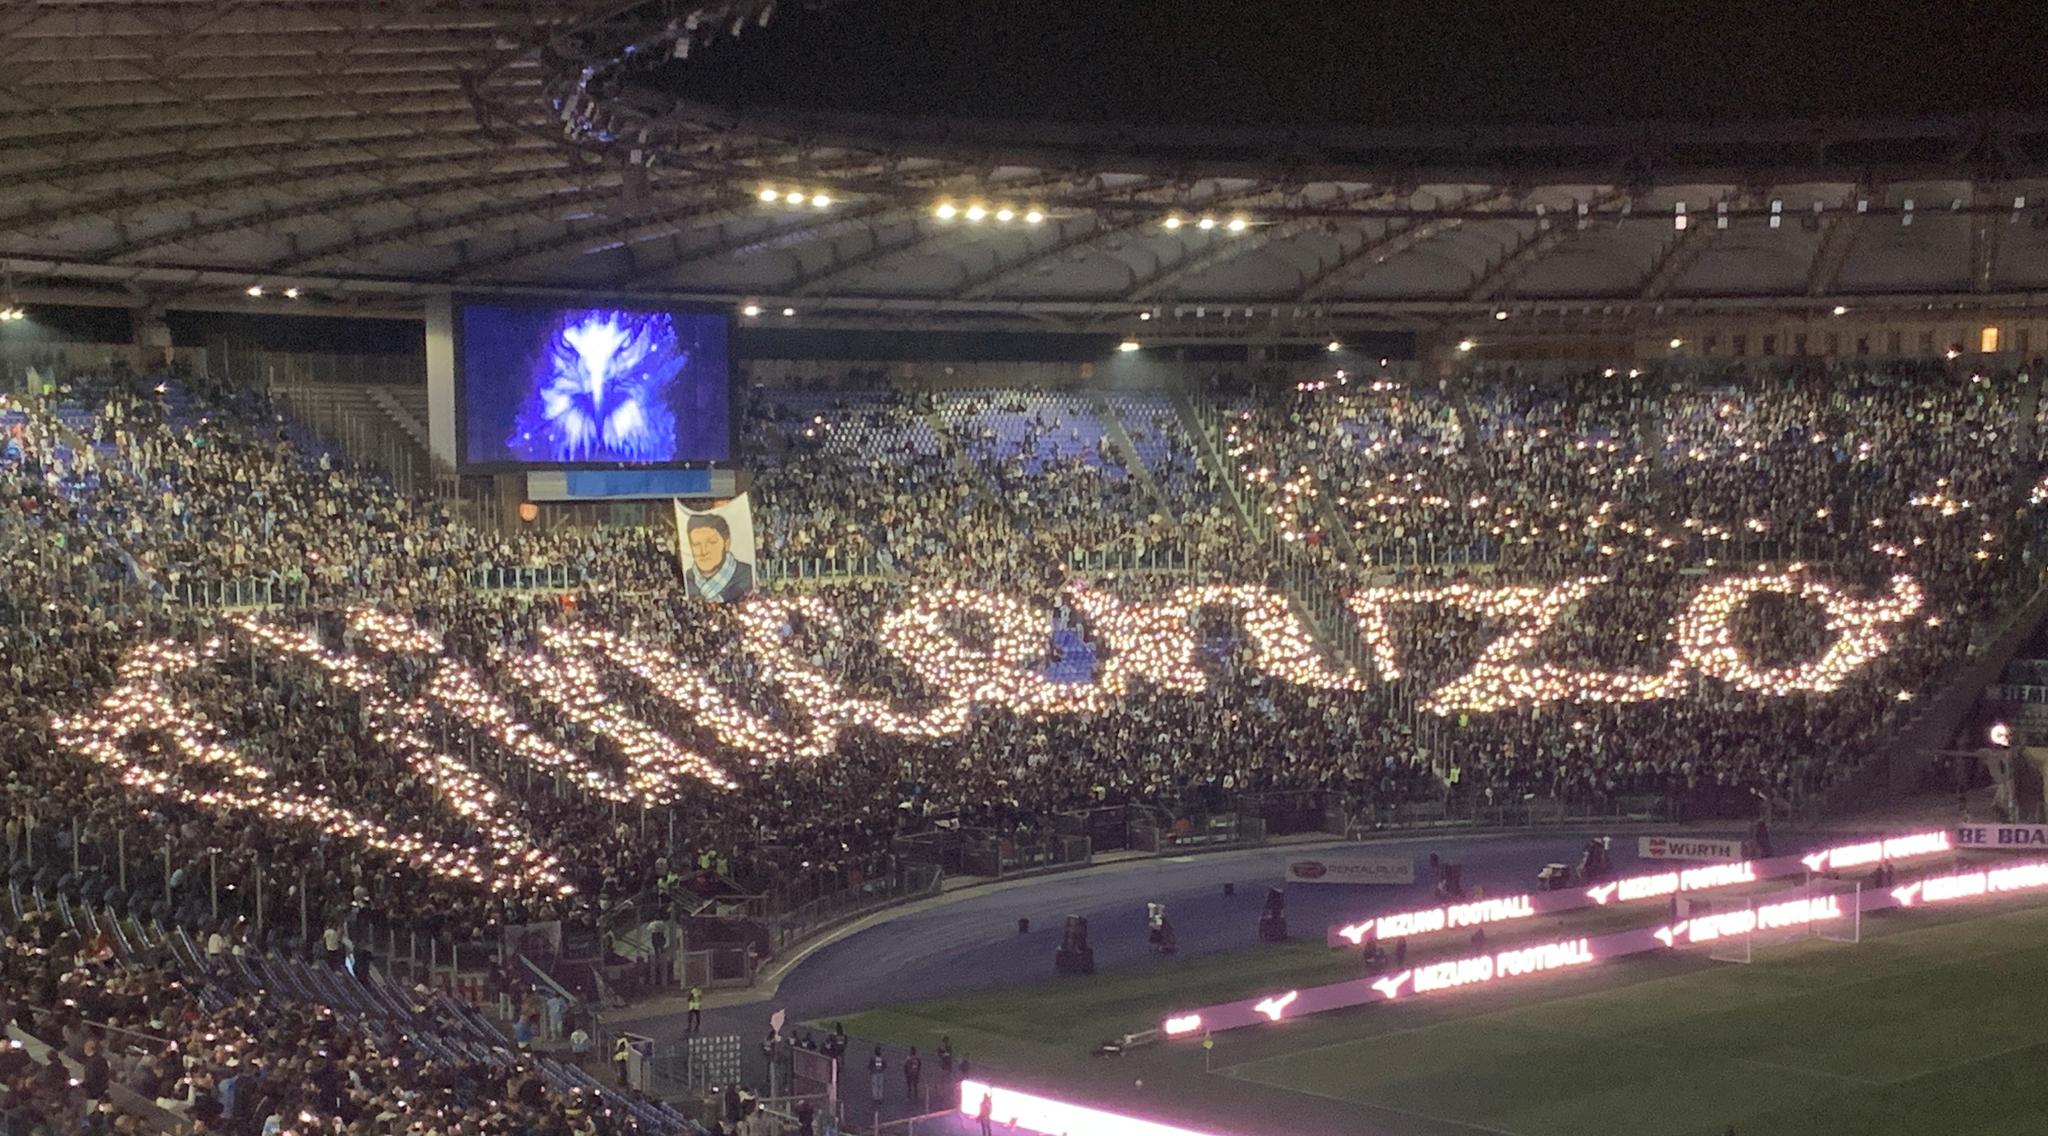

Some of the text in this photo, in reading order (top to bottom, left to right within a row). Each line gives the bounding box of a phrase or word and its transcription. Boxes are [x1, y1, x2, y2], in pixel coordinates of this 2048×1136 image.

[1669, 842, 1730, 857] WÜRTH
[1958, 828, 1986, 844] BE
[1680, 861, 1755, 891] FOOTBALL
[1376, 895, 1534, 940] MIZUNO FOOTBALL
[1757, 895, 1841, 929] FOOTBALL
[1414, 938, 1593, 993] MIZUNO FOOTBALL
